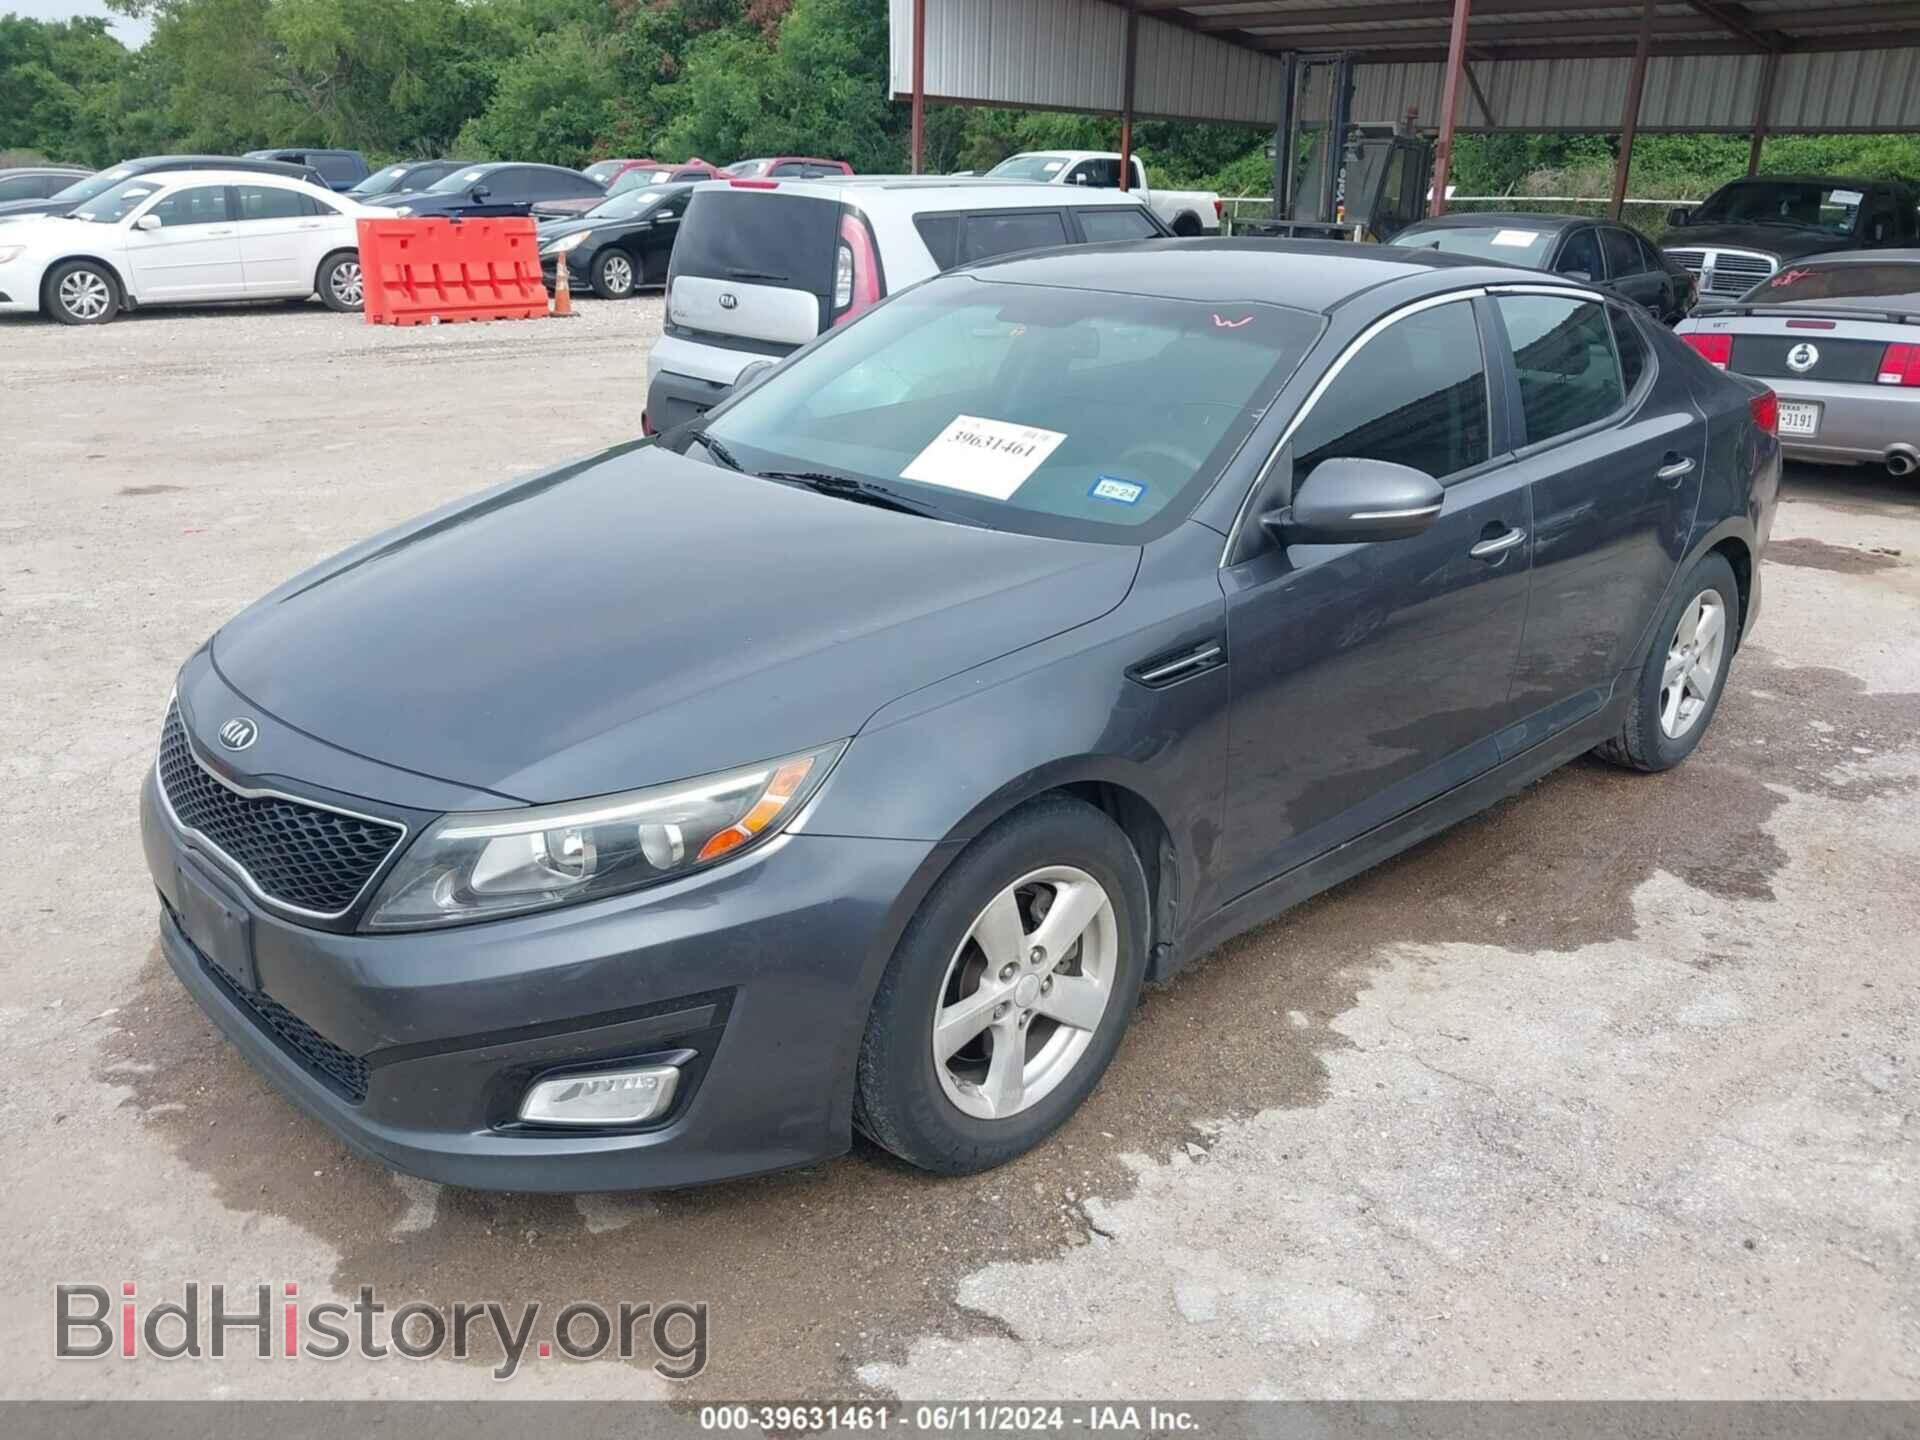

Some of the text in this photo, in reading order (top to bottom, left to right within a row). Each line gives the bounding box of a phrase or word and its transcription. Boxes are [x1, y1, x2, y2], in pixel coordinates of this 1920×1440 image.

[1335, 167, 1346, 202] Yale
[720, 294, 736, 307] KIA
[948, 430, 1037, 457] 39631461
[221, 719, 251, 747] KIA
